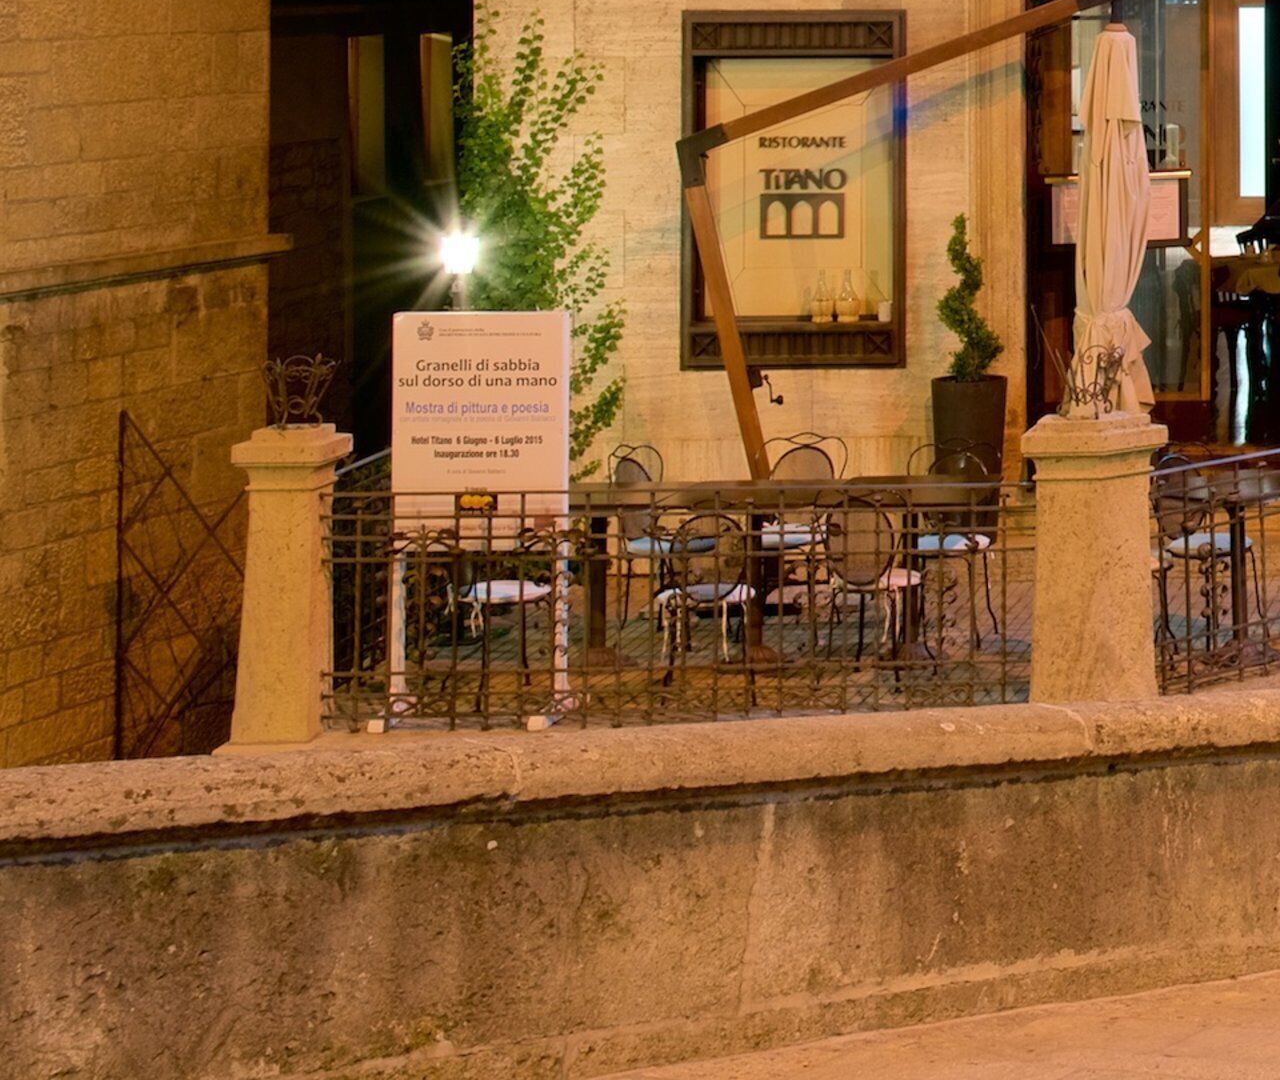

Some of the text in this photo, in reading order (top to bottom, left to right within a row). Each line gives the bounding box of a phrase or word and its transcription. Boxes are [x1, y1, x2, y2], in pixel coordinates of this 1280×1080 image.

[758, 136, 847, 149] RISTORANTE
[416, 358, 540, 372] Granelli di sabbia
[398, 374, 557, 387] sul dorso di una mano
[405, 401, 549, 416] Mostra di pittura e poesia
[411, 436, 430, 445] Hotel
[431, 436, 453, 445] Titano
[456, 436, 461, 444] 6
[463, 436, 487, 446] Giugno
[501, 435, 523, 446] Luglio
[525, 435, 543, 444] 2015
[434, 449, 484, 460] Inaugurazione
[499, 449, 519, 458] 18.30
